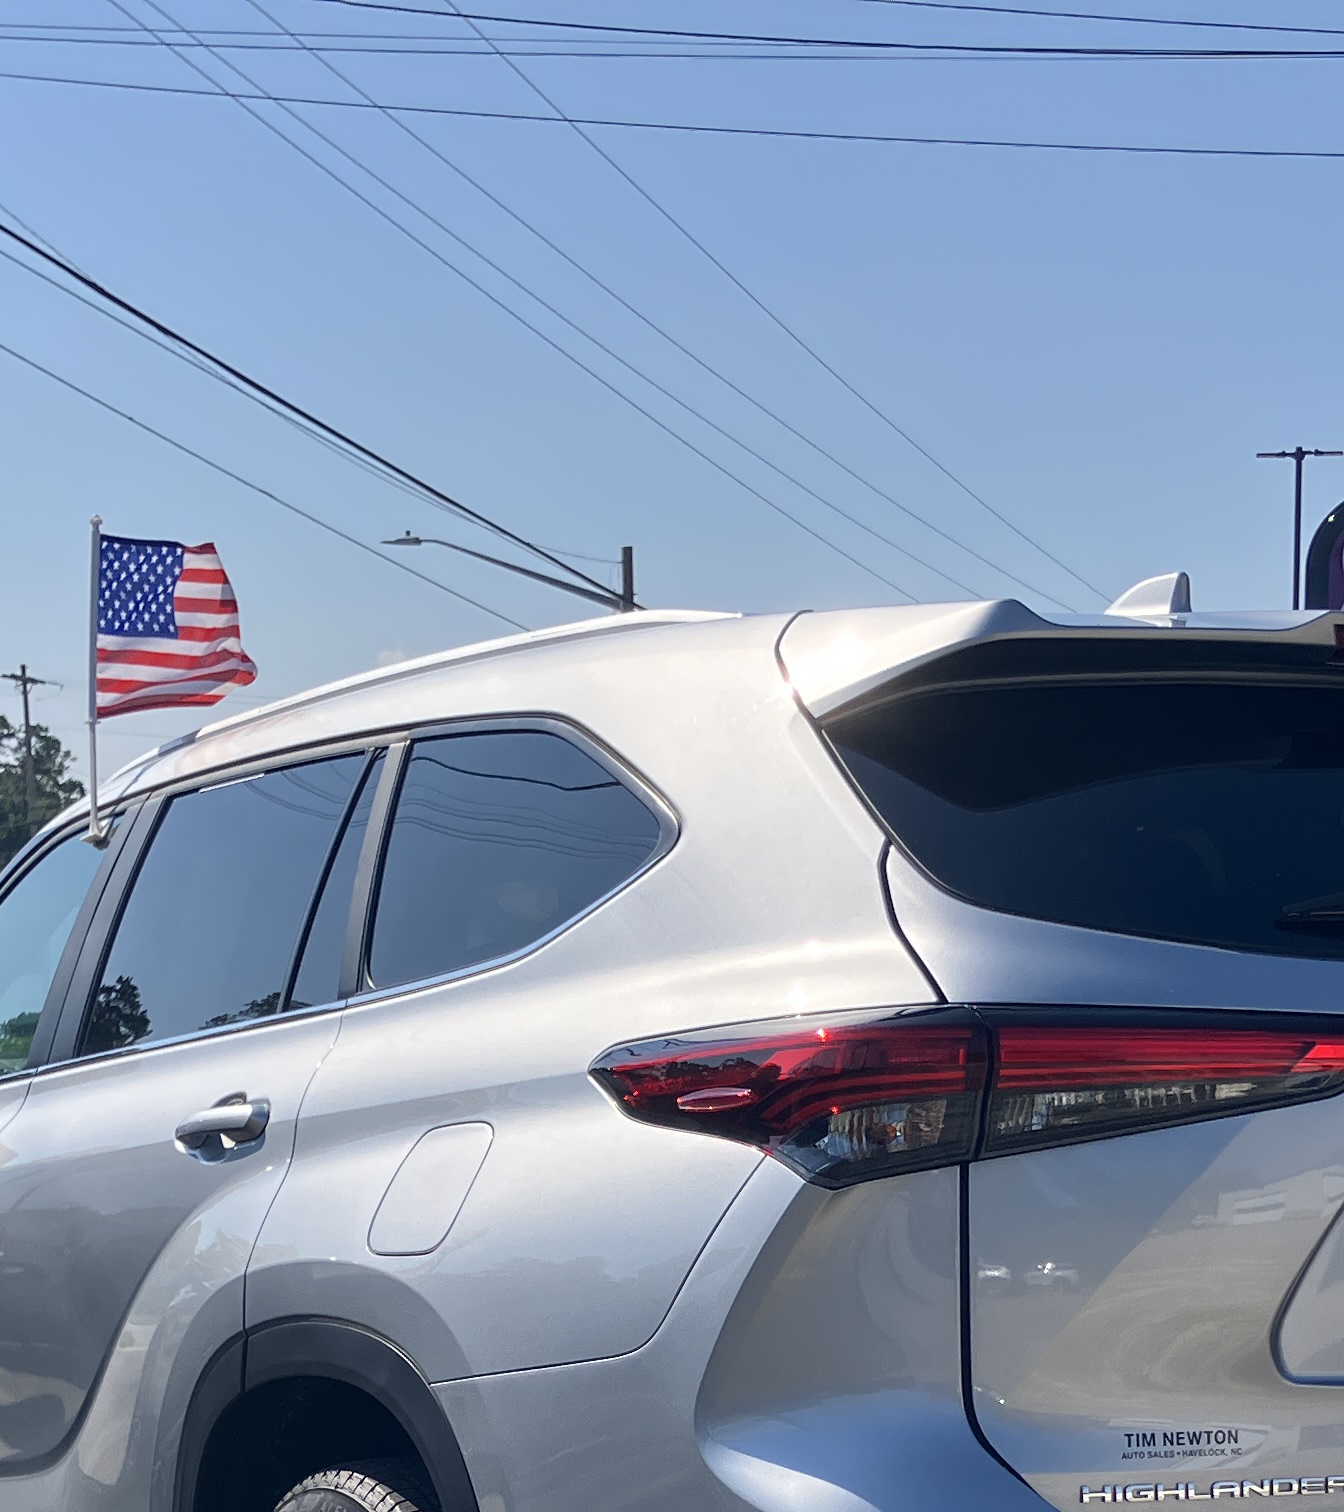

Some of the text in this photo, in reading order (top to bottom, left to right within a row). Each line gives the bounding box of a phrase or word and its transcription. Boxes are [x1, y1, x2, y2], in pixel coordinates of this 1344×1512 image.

[1124, 1430, 1239, 1448] TIM NEWTON
[1121, 1451, 1145, 1460] AUTO
[1147, 1450, 1174, 1459] SALES
[1230, 1447, 1242, 1456] NC
